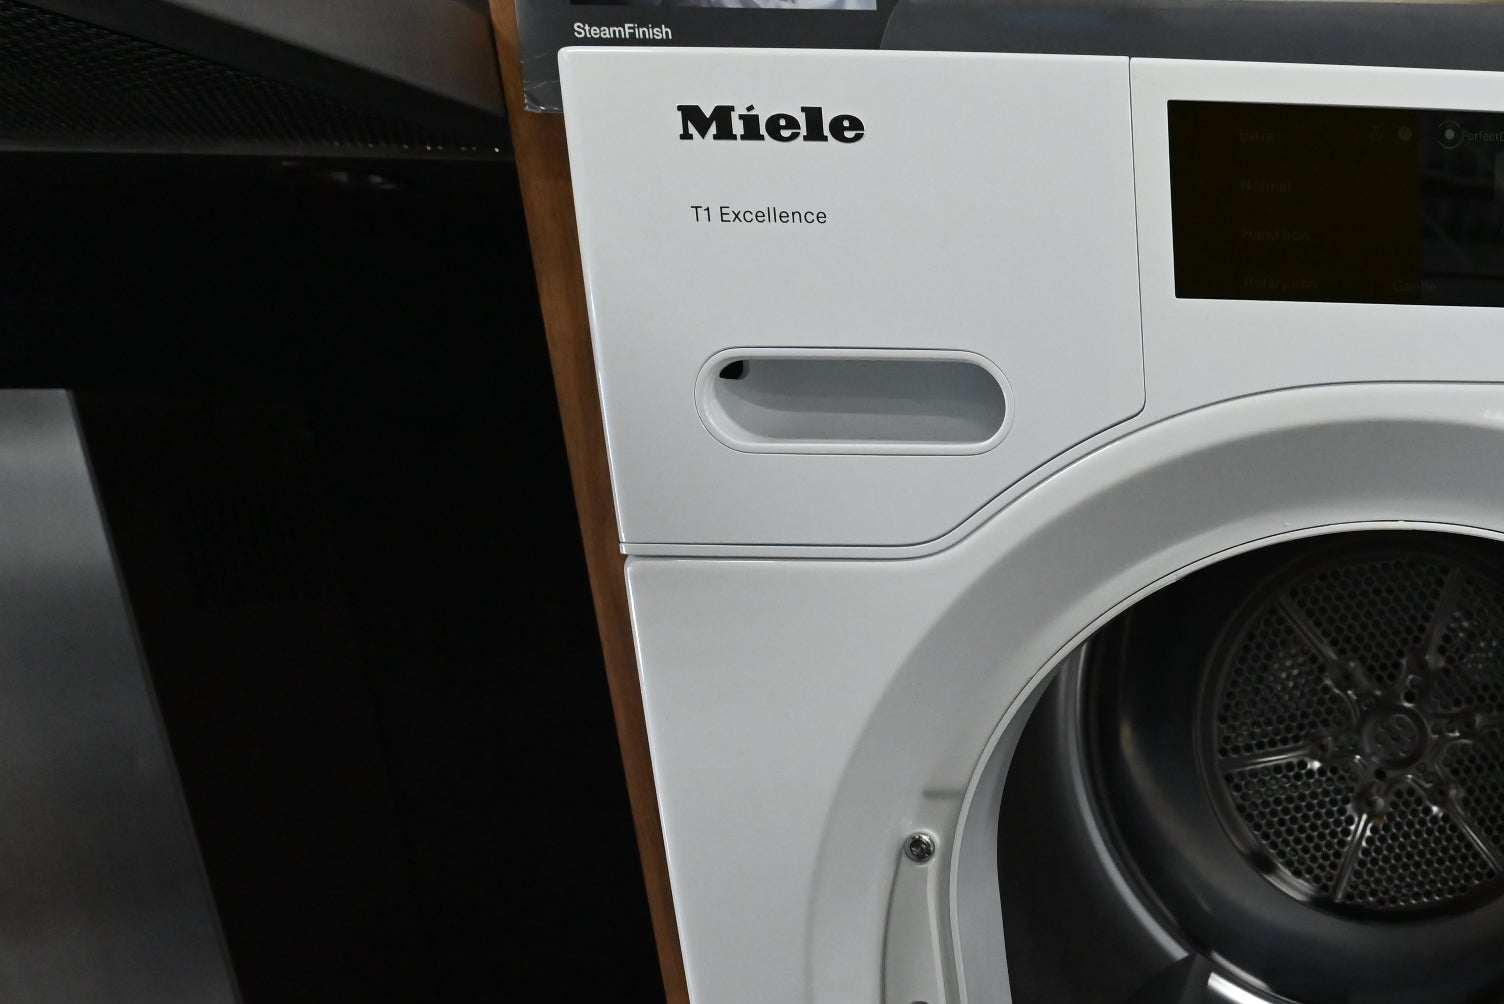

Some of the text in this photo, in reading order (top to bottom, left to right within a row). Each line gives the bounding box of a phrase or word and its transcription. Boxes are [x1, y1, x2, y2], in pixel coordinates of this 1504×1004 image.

[574, 22, 672, 41] SteamFinish
[677, 104, 865, 144] Miele
[691, 206, 827, 225] T1 Excellence
